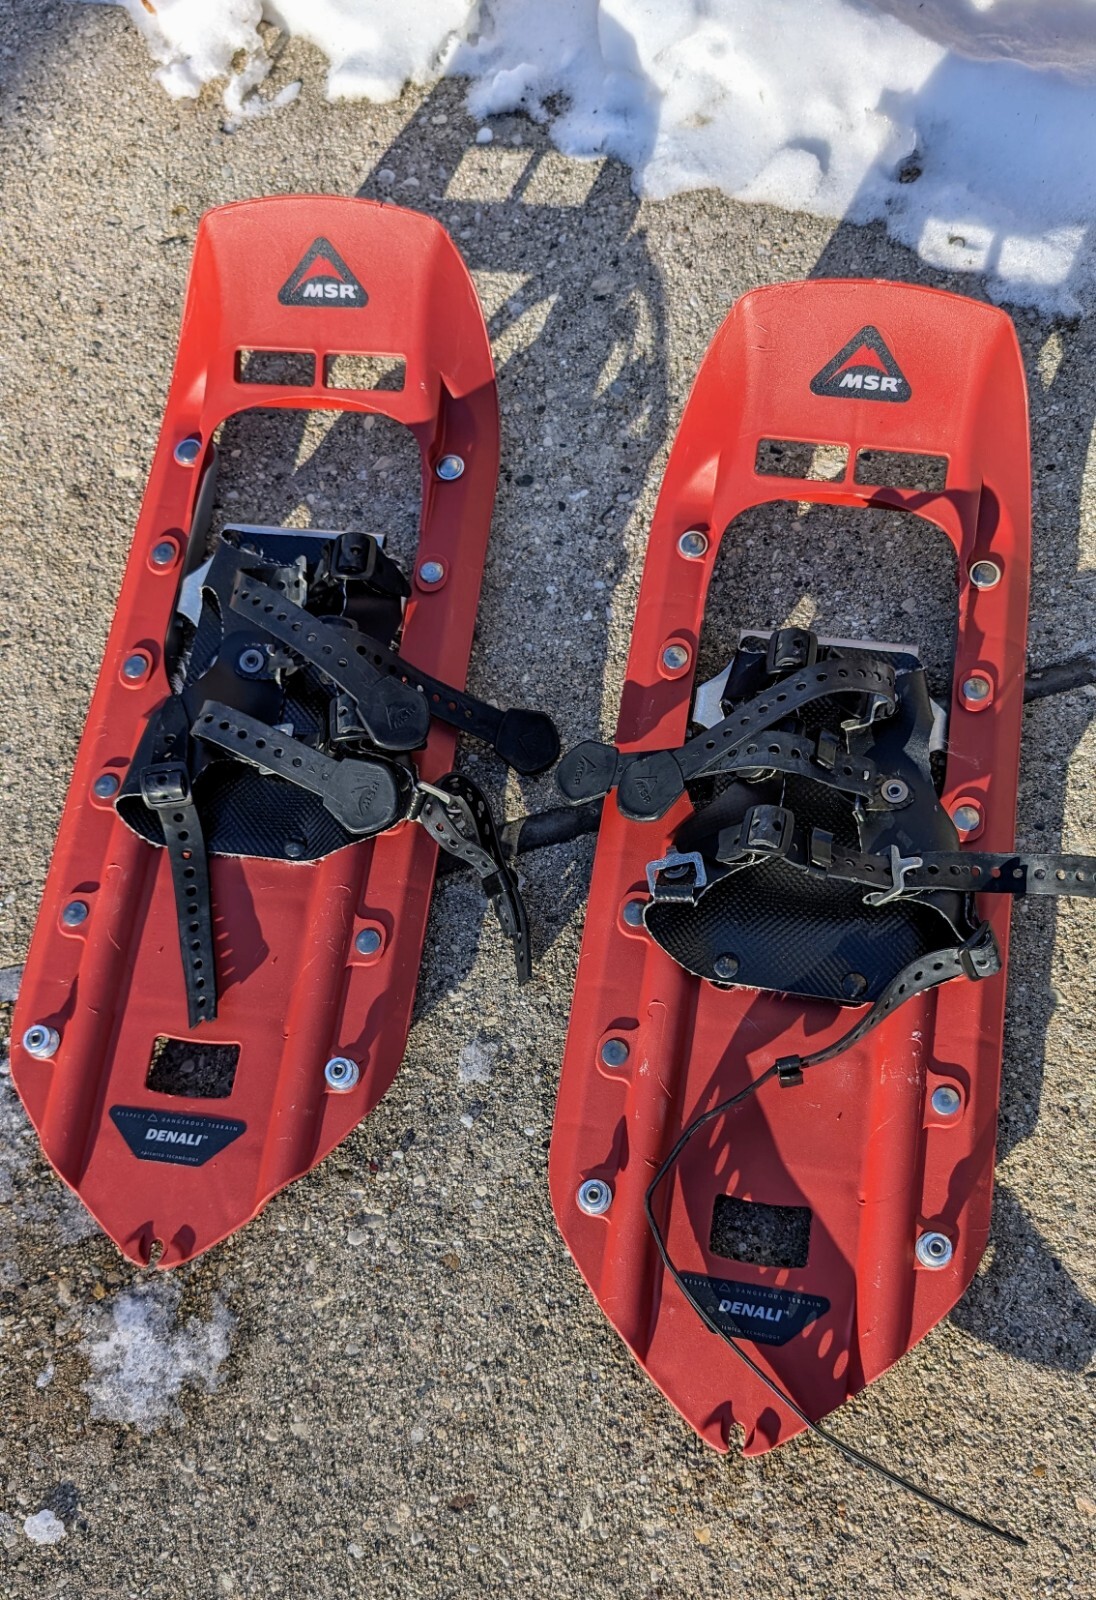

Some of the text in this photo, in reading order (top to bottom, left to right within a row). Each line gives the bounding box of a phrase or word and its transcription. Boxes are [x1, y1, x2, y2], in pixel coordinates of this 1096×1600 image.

[303, 283, 358, 299] MSR
[839, 373, 900, 393] MSR
[161, 1117, 204, 1127] DANGEROUS
[208, 1122, 238, 1132] TERRAIN
[735, 1287, 784, 1300] DANGEROUS
[788, 1296, 822, 1308] TERRAIN
